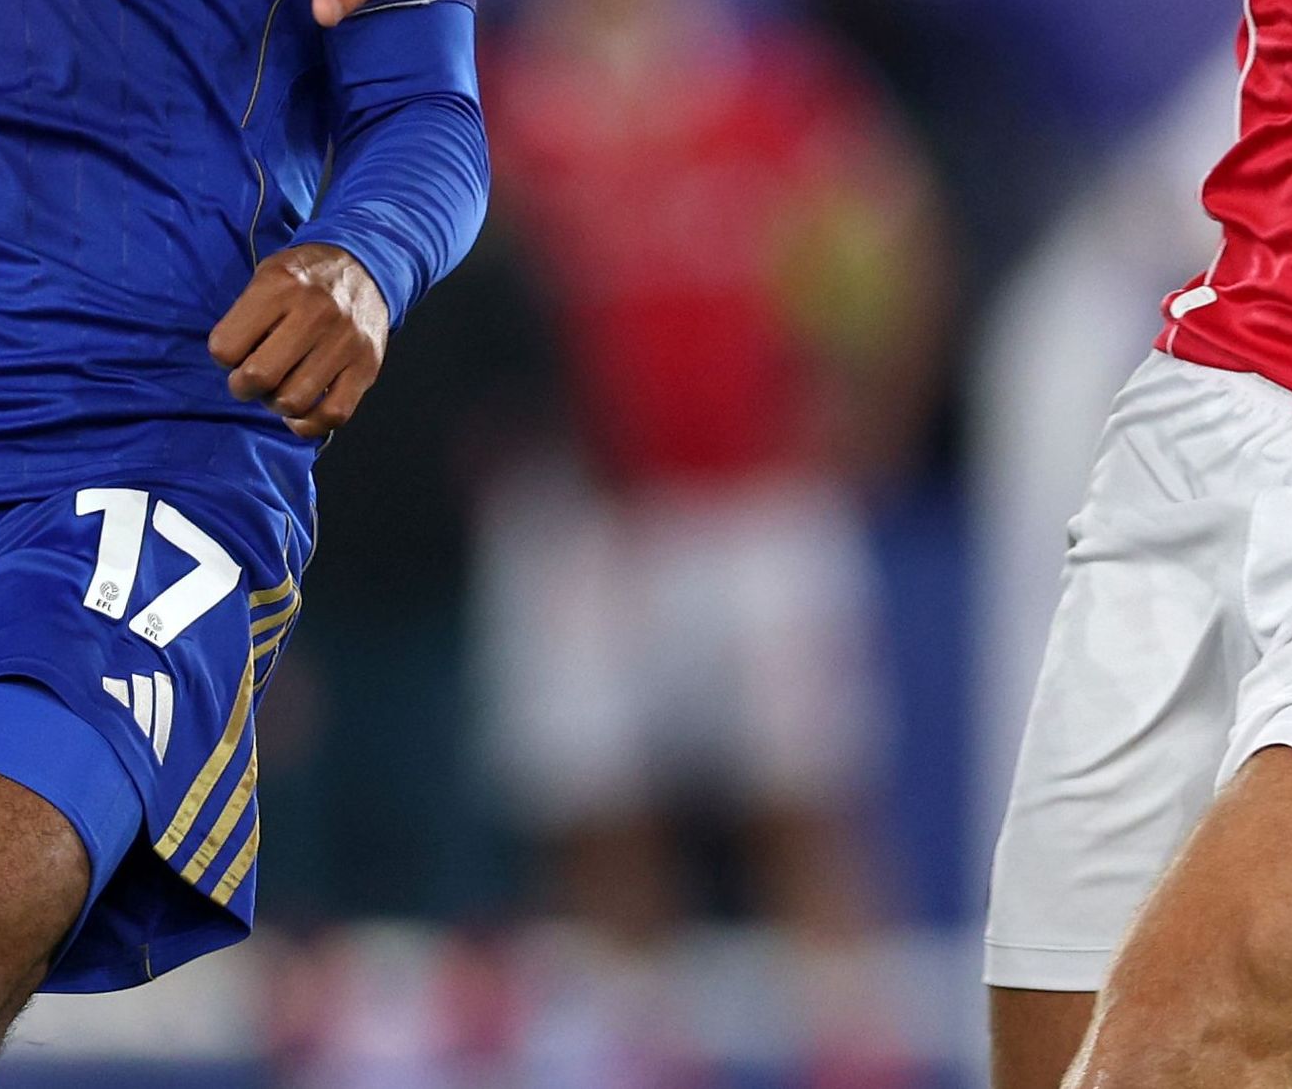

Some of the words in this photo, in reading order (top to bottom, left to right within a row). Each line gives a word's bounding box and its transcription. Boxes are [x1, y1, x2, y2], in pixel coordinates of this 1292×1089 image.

[76, 489, 242, 648] 17
[96, 598, 111, 612] EFL
[144, 626, 158, 641] EFL
